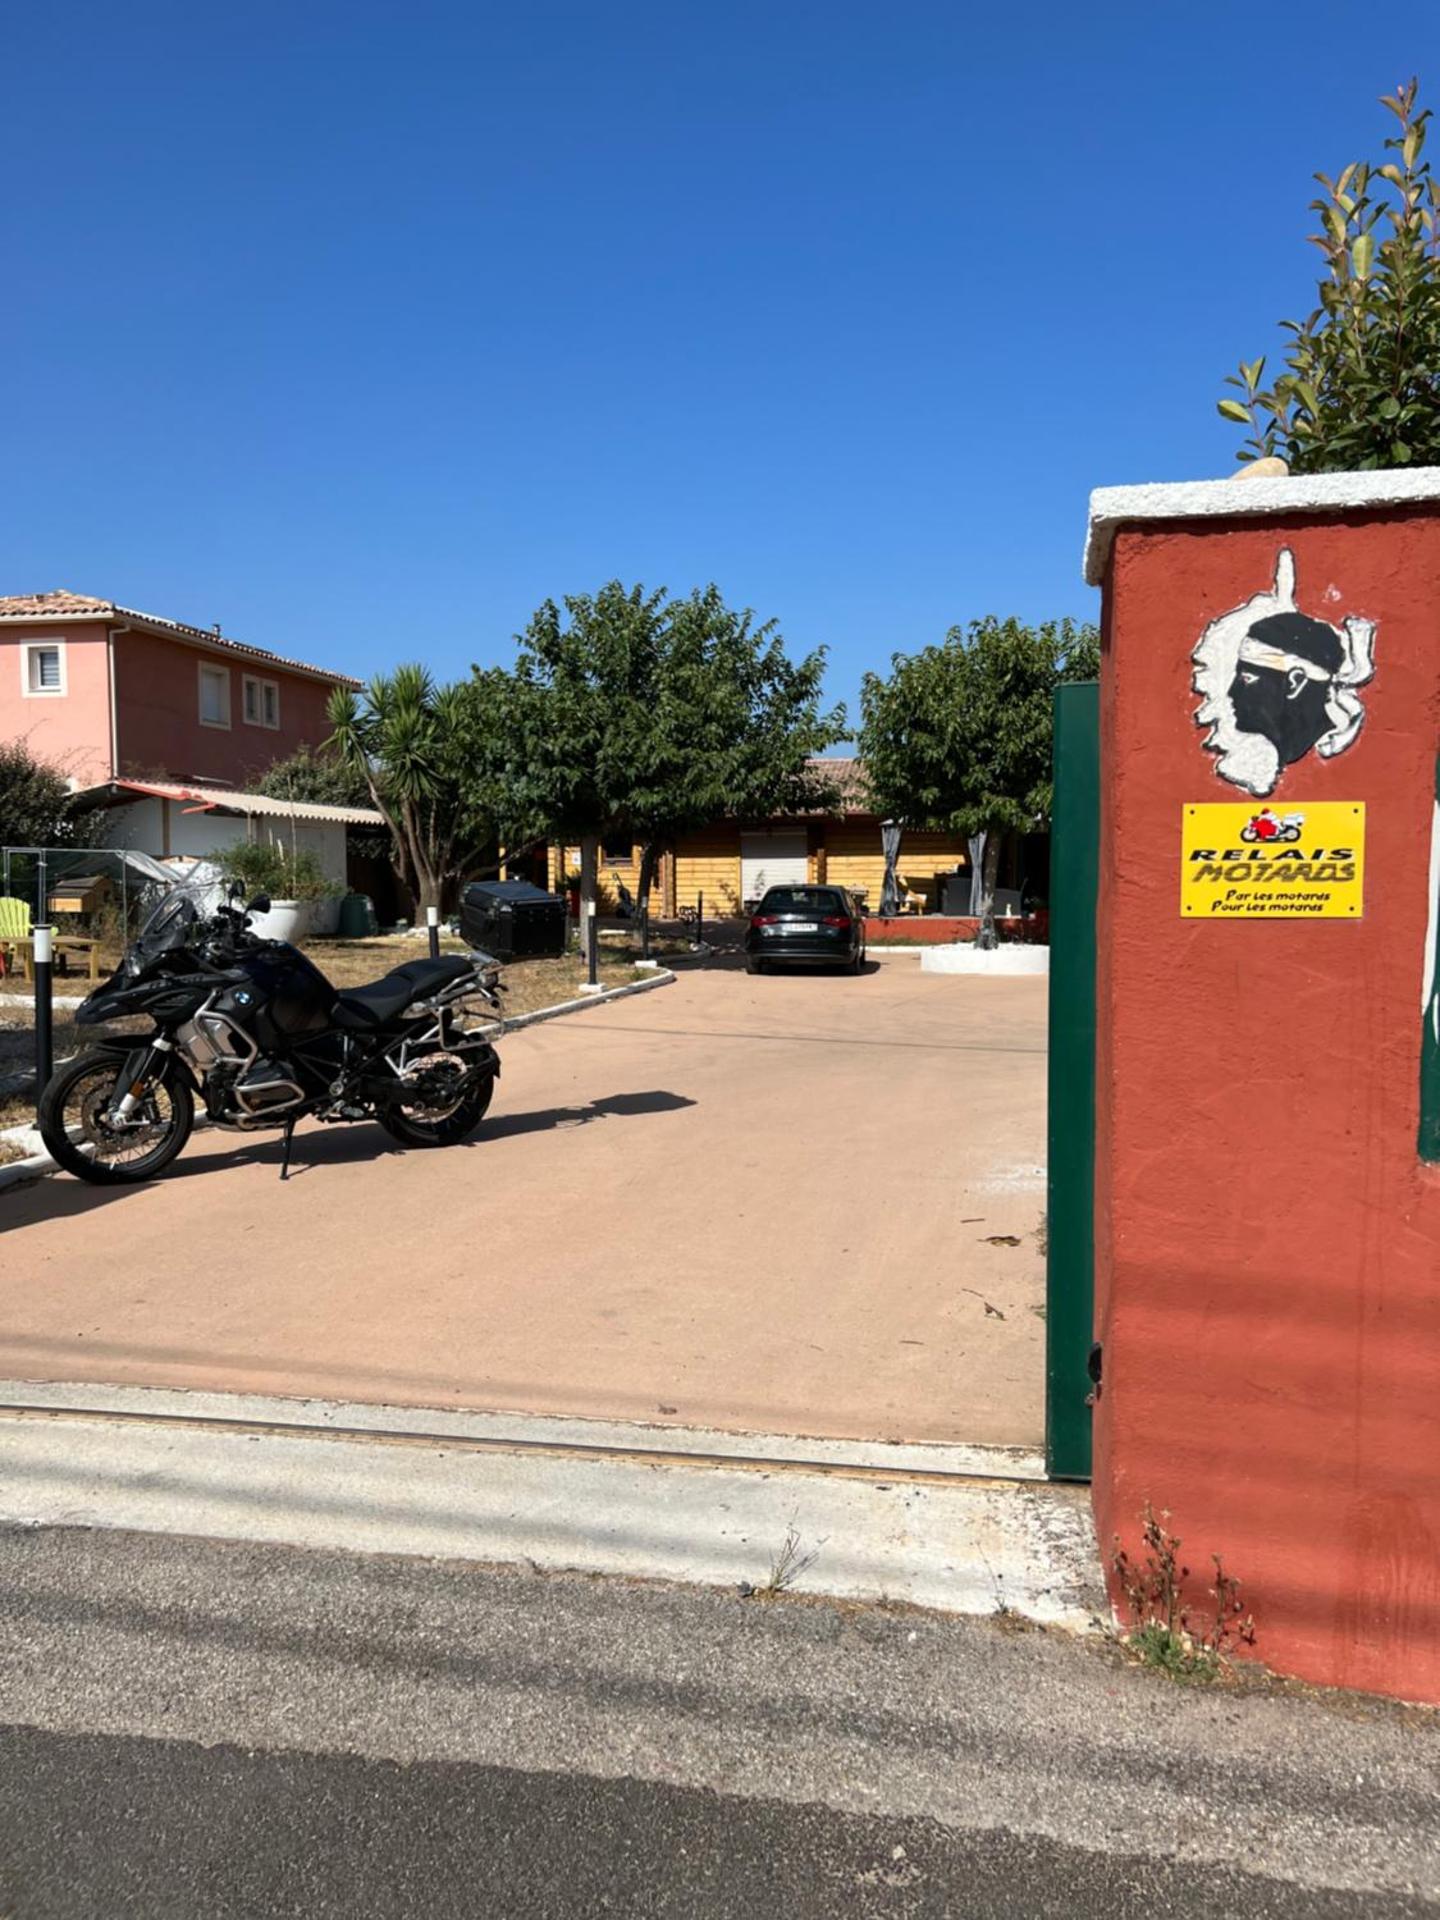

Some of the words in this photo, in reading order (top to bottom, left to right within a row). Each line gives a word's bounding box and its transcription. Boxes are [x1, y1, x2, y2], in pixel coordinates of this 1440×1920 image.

[1190, 848, 1354, 861] RELAIS
[1192, 863, 1356, 882] MOTARDS
[1225, 889, 1250, 901] Par
[1276, 891, 1331, 901] motards
[1211, 900, 1244, 912] Pour
[1268, 902, 1323, 912] motards
